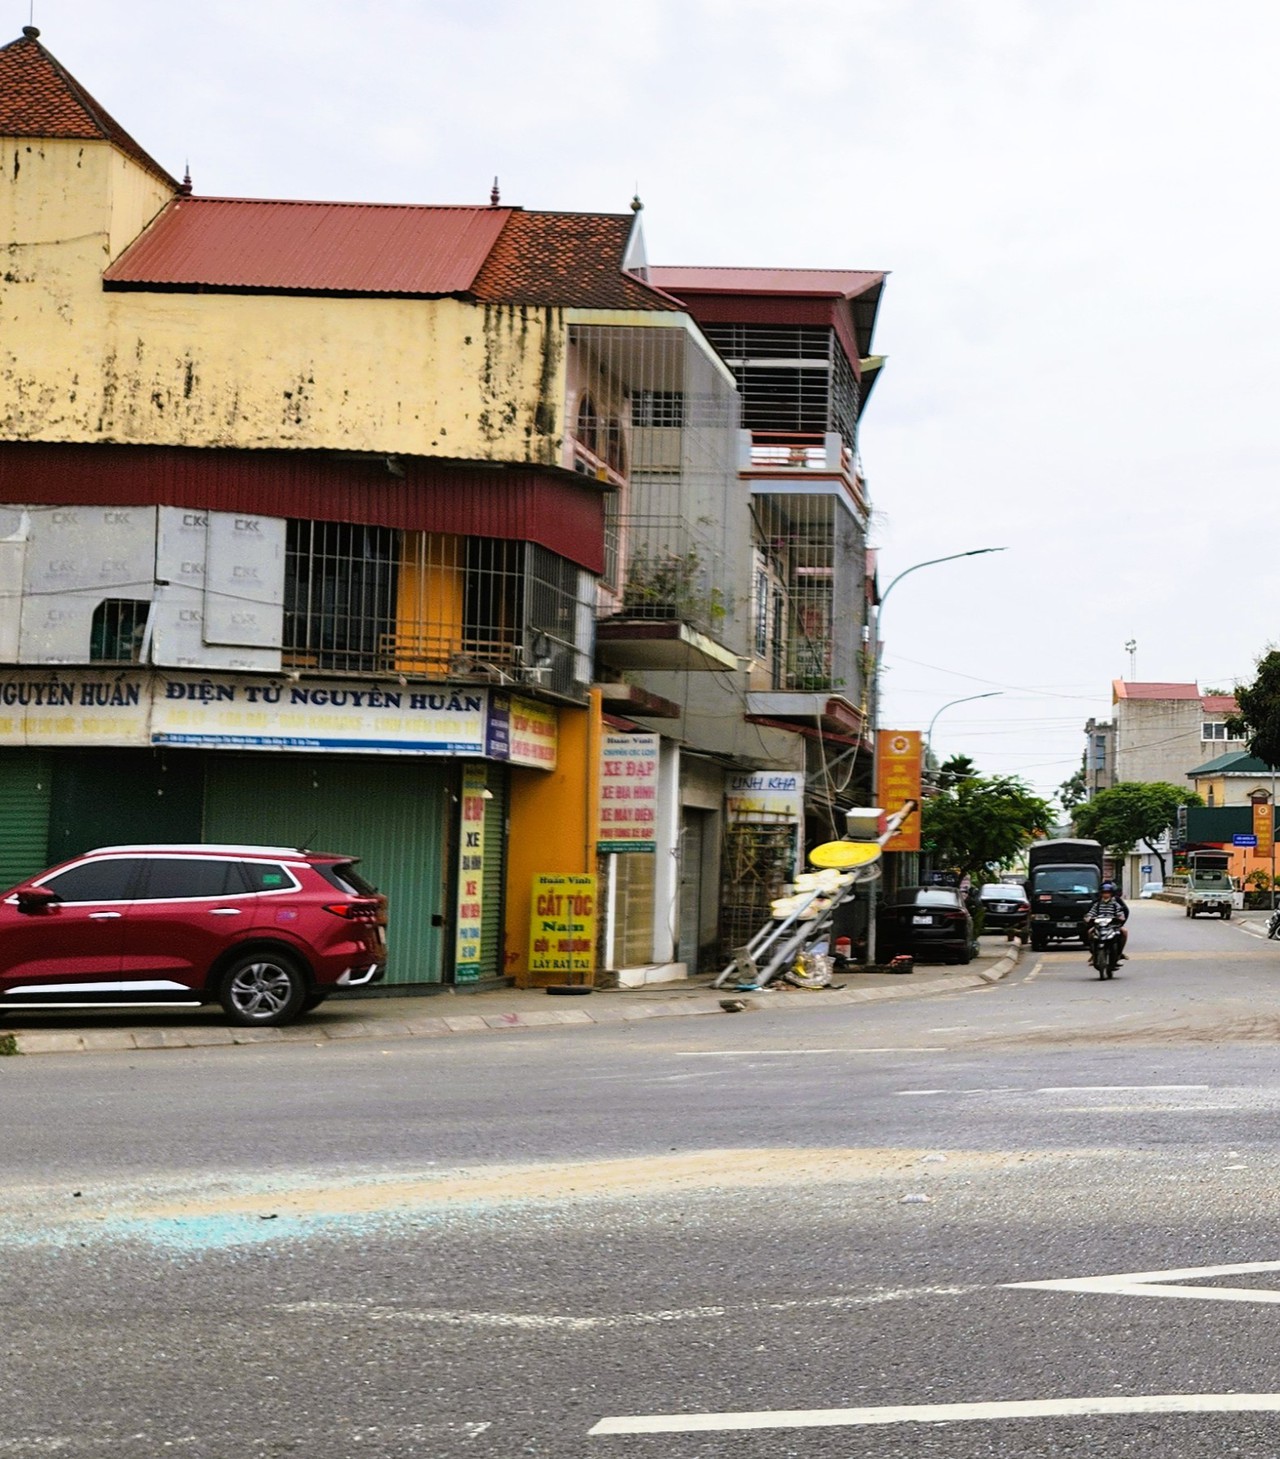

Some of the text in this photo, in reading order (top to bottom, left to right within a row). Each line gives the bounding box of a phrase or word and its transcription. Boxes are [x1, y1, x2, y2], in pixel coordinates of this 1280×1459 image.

[165, 679, 236, 705] ĐIỆN
[244, 679, 283, 703] TỬ
[408, 688, 481, 712] HUẤN
[604, 761, 655, 780] XE ĐẠP
[602, 785, 614, 799] XE
[601, 807, 613, 821] XE
[466, 832, 481, 848] XE
[568, 876, 591, 884] Vinh
[466, 881, 477, 896] XE
[537, 887, 593, 917] CẮT TÓC
[543, 921, 585, 932] Nam
